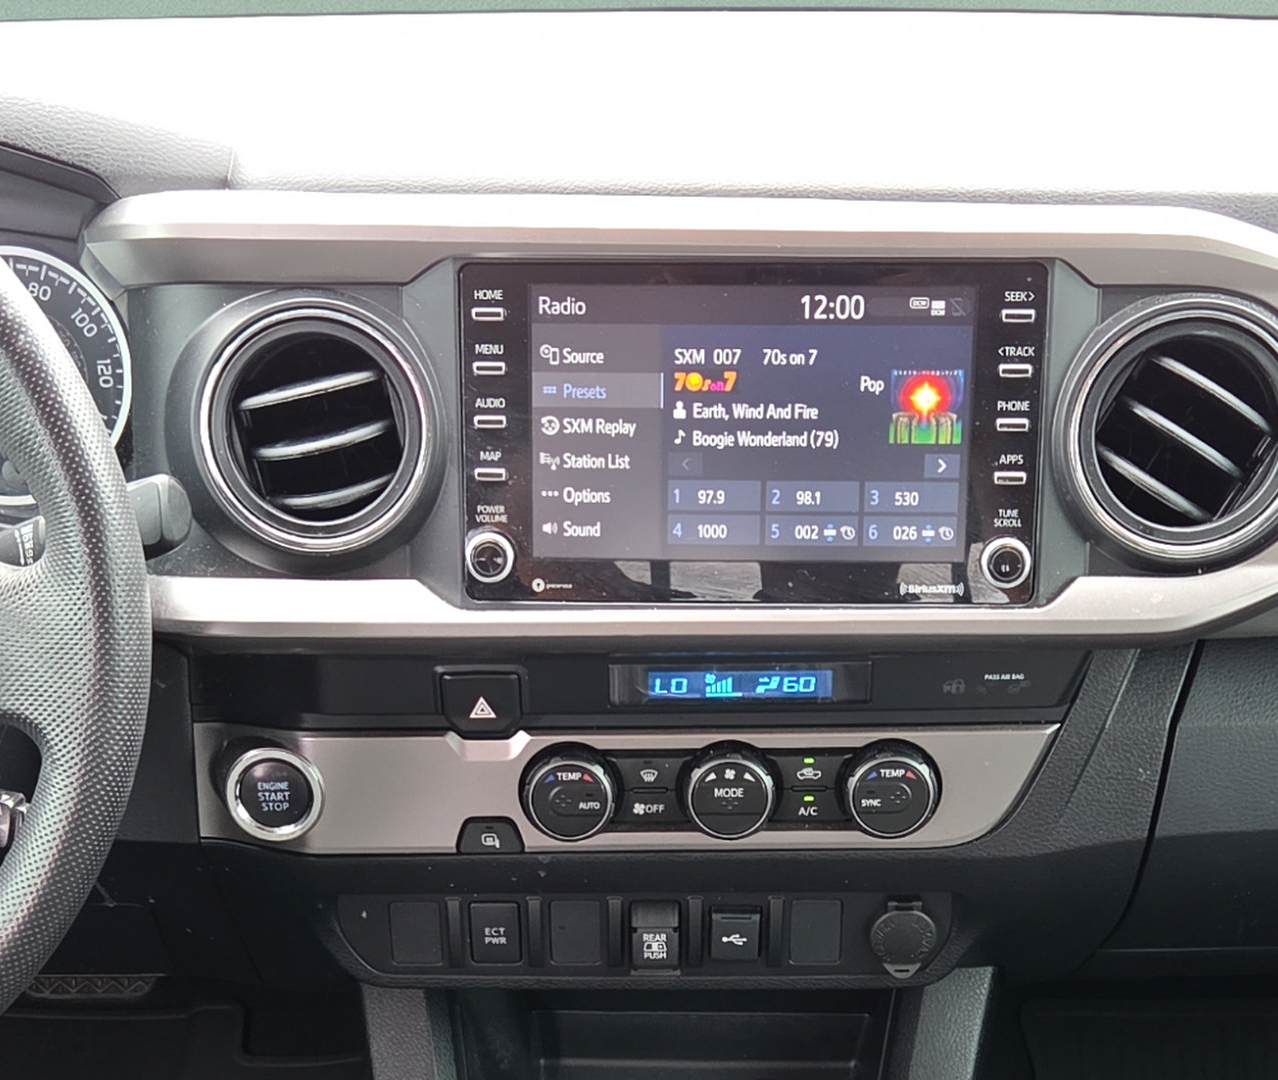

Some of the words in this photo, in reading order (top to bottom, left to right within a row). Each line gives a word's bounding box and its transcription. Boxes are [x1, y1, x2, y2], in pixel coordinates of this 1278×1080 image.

[28, 282, 52, 301] 80
[474, 289, 503, 301] HOME
[538, 295, 586, 316] Radio
[800, 294, 865, 320] 12:00
[71, 307, 98, 338] 100
[475, 344, 504, 354] MENU
[562, 347, 604, 364] Source
[674, 348, 705, 365] SXM
[713, 348, 742, 365] 007
[762, 348, 787, 365] 70s
[789, 353, 805, 365] on
[808, 348, 818, 366] 7
[96, 358, 114, 388] 120
[859, 375, 885, 395] Pop
[563, 383, 607, 399] Presets
[475, 398, 506, 408] AUDIO
[997, 401, 1030, 411] PHONE
[692, 402, 730, 421] Earth,
[731, 403, 764, 419] Wind
[766, 403, 792, 419] And
[794, 403, 819, 419] Fire
[563, 418, 594, 434] SXM
[596, 418, 636, 437] Replay
[692, 430, 735, 449] Boogie
[737, 430, 808, 447] Wonderland
[809, 429, 840, 449] (79)
[480, 451, 502, 461] MAP
[563, 453, 605, 469] Station
[608, 453, 631, 469] List
[999, 454, 1024, 465] APPS
[563, 487, 611, 506] Options
[673, 488, 680, 503] 1
[697, 489, 726, 505] 97.9
[771, 489, 781, 504] 2
[796, 490, 821, 506] 98.1
[870, 489, 879, 505] 3
[894, 491, 919, 506] 530
[477, 505, 505, 514] POWER
[998, 509, 1019, 518] TUNE
[475, 514, 508, 523] VOLUME
[993, 518, 1022, 527] SCROLL
[563, 521, 601, 537] Sound
[672, 523, 682, 538] 4
[697, 524, 727, 539] 1000
[771, 524, 780, 539] 5
[794, 524, 819, 540] 002
[868, 524, 878, 540] 6
[893, 526, 918, 540] 026
[654, 677, 688, 694] LO
[782, 676, 816, 693] 60
[556, 772, 582, 781] TEMP
[879, 768, 905, 778] TEMP
[257, 781, 289, 791] ENGINE
[257, 791, 290, 801] START
[713, 787, 745, 798] MODE
[261, 802, 290, 811] STOP
[578, 801, 601, 810] AUTO
[645, 804, 665, 814] OFF
[861, 799, 882, 808] SYNC
[798, 806, 819, 817] A/C
[484, 927, 506, 936] ECT
[484, 936, 508, 945] PWR
[642, 933, 667, 942] REAR
[643, 951, 667, 960] PUSH
